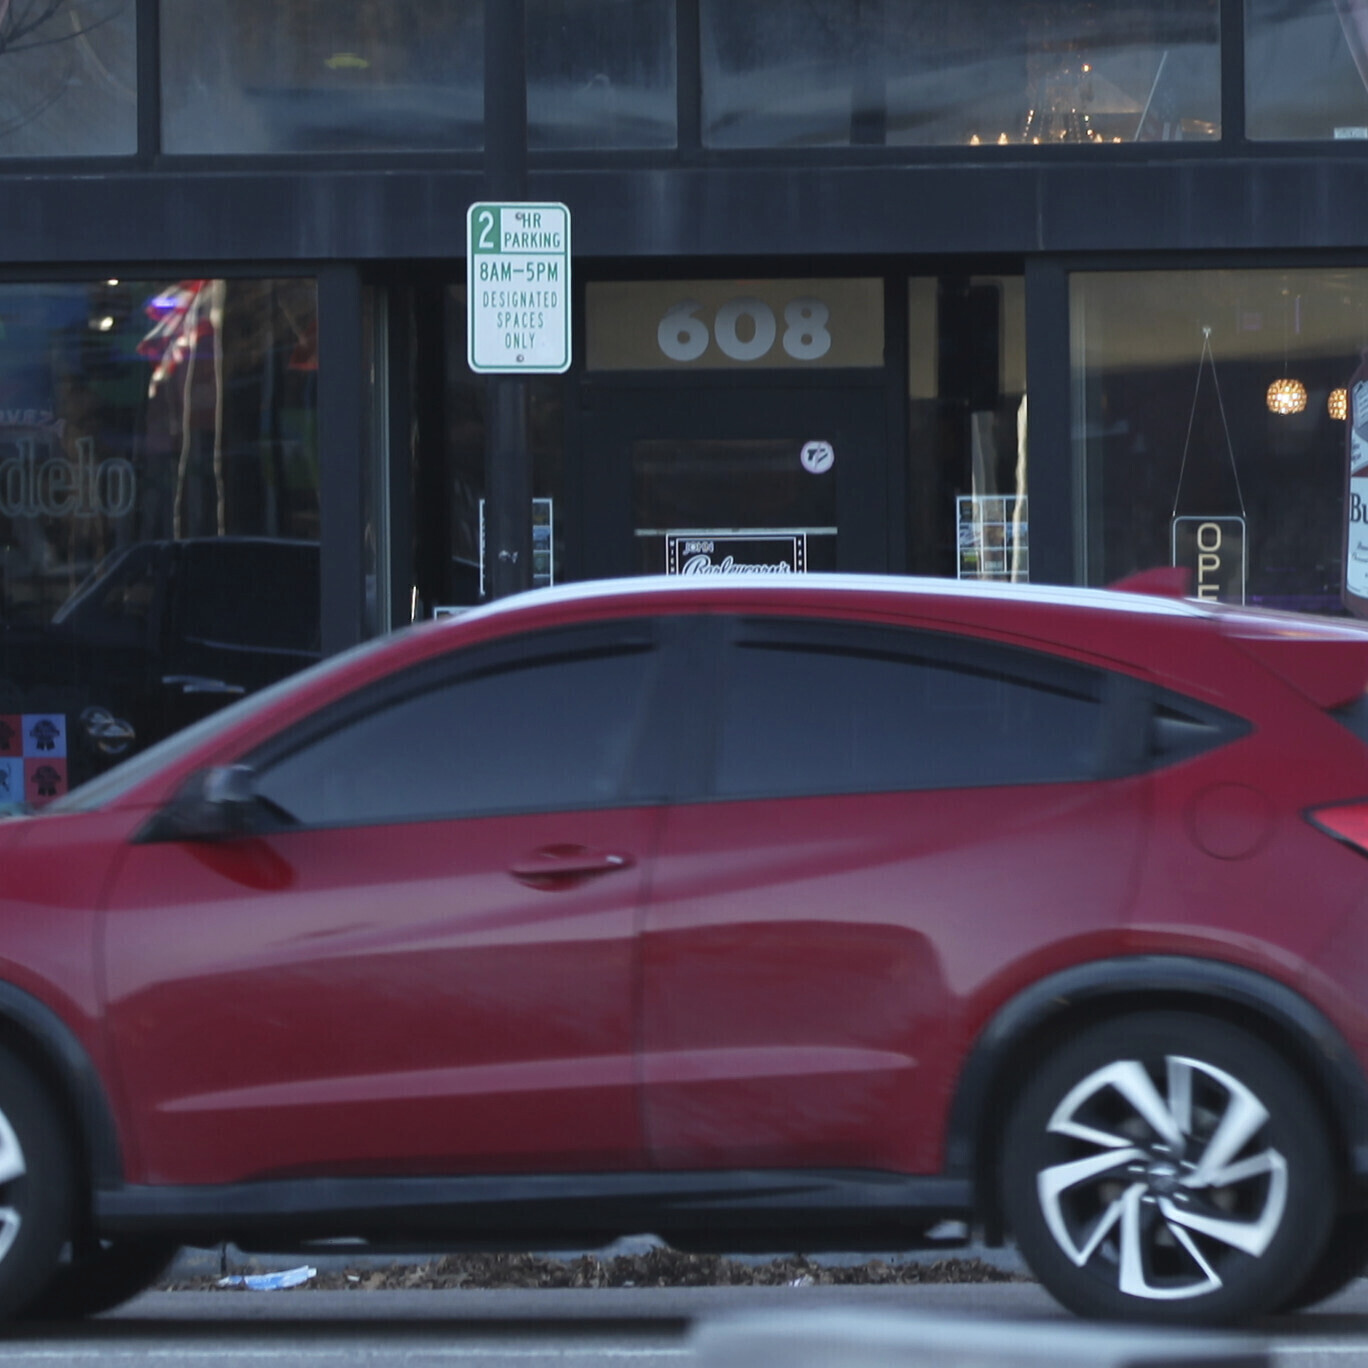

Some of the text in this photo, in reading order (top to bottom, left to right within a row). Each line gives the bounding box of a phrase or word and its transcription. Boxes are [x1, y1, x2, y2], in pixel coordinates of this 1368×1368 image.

[477, 210, 542, 249] 2 HR
[504, 232, 561, 249] PARKING
[483, 290, 558, 308] DESIGNATED
[496, 311, 544, 329] SPACES
[657, 295, 832, 362] 608
[504, 332, 536, 349] ONLY
